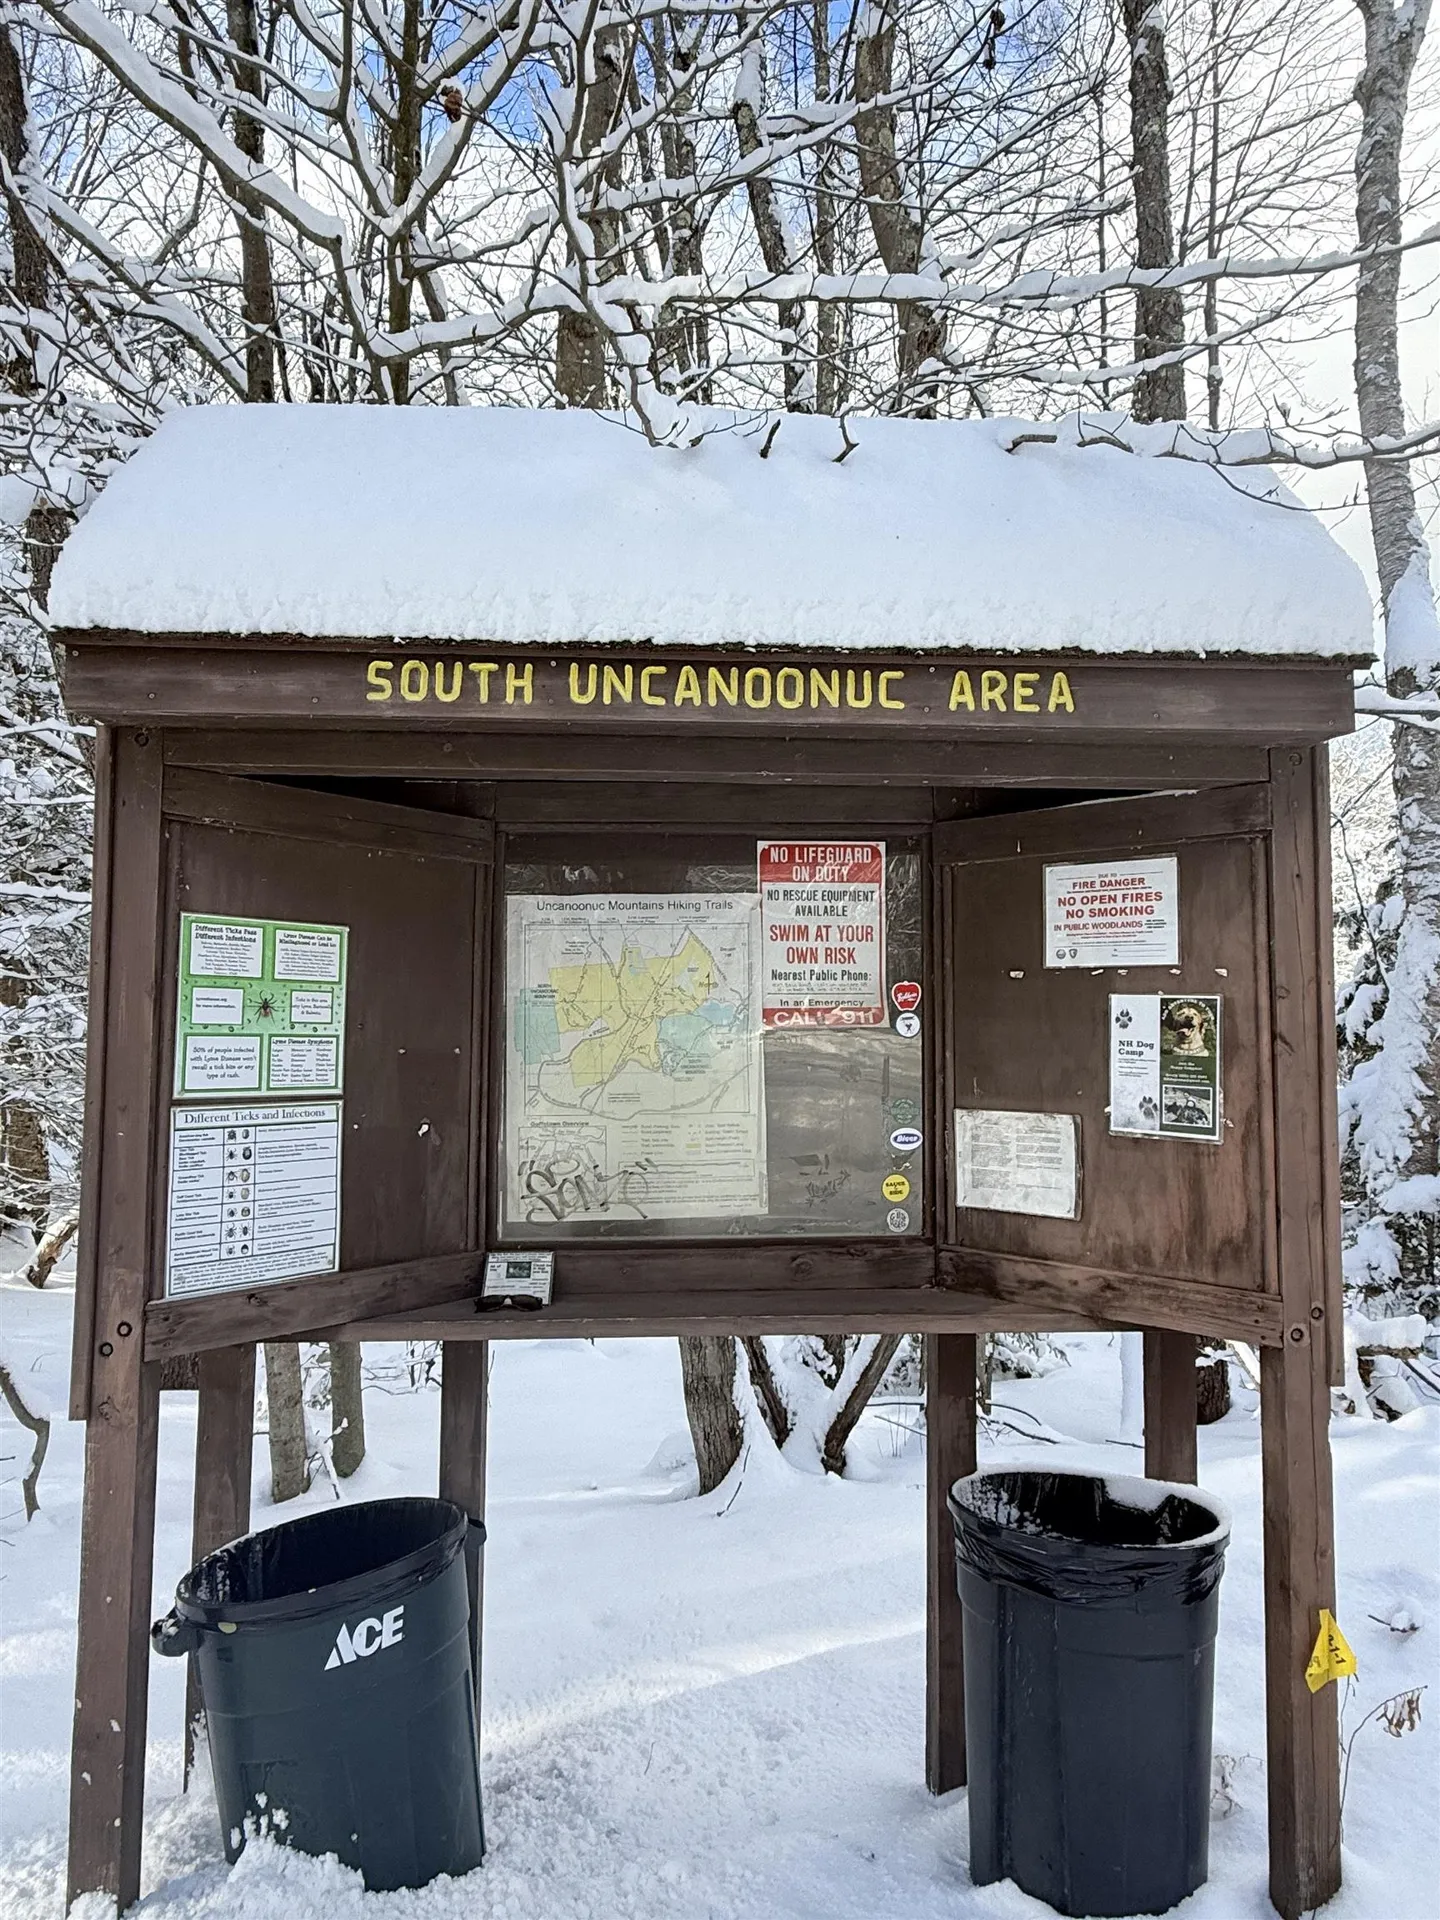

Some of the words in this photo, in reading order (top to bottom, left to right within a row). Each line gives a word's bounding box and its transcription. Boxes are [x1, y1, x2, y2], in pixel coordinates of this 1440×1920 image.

[366, 661, 533, 704] SOUTH
[569, 664, 904, 710] UNCANOONUC
[949, 670, 1075, 712] AREA
[770, 847, 788, 863] NO
[795, 848, 872, 863] LIFEGUARD
[792, 866, 808, 881] ON
[816, 866, 849, 881] DUTY
[1073, 881, 1096, 890] FIRE
[1100, 878, 1145, 888] DANGER
[768, 890, 780, 901] NO
[783, 890, 818, 901] RESCUE
[822, 890, 875, 902] EQUIPMENT
[1058, 897, 1076, 907] NO
[1081, 894, 1117, 905] OPEN
[1122, 892, 1163, 903] FIRES
[537, 901, 605, 911] Uncanoonuc
[609, 901, 664, 910] Mountains
[668, 900, 700, 911] Hiking
[705, 900, 733, 910] Trails
[795, 906, 848, 916] AVAILABLE
[1066, 909, 1084, 919] NO
[1088, 905, 1154, 918] SMOKING
[1092, 921, 1143, 930] WOODLANDS
[770, 925, 809, 942] SWIM
[815, 925, 832, 942] AT
[837, 925, 874, 942] YOUR
[787, 947, 818, 964] OWN
[825, 947, 856, 964] RISK
[772, 970, 806, 981] Nearest
[810, 970, 838, 981] Public
[841, 970, 872, 981] Phone:
[841, 1011, 875, 1023] 911
[185, 1113, 229, 1124] Different
[232, 1111, 259, 1121] Ticks
[262, 1110, 279, 1120] and
[282, 1109, 325, 1119] Infections
[324, 1605, 404, 1670] ACE
